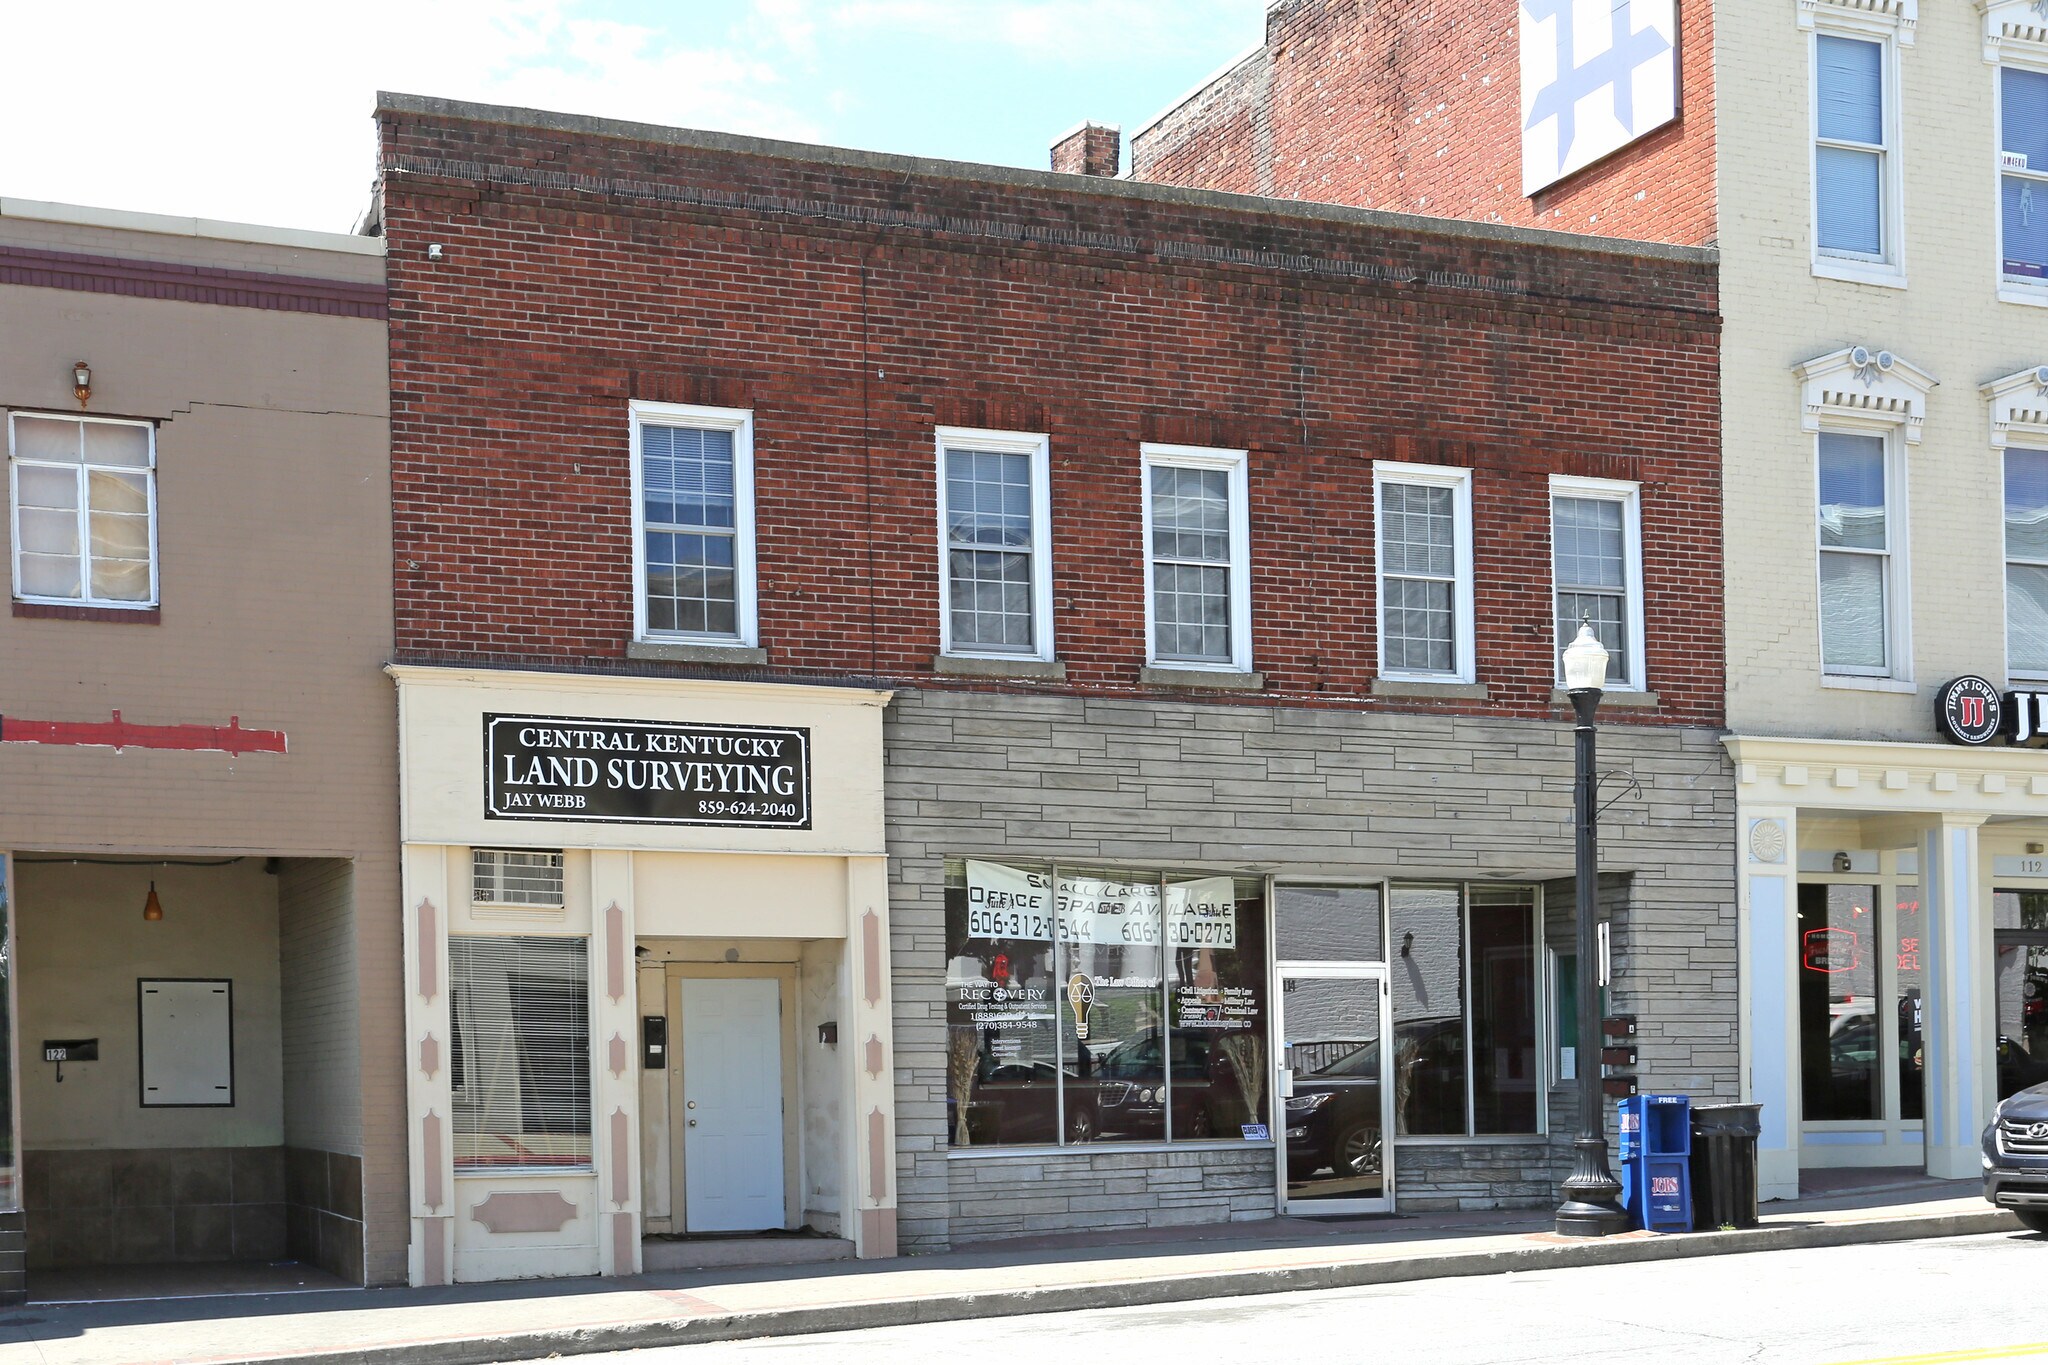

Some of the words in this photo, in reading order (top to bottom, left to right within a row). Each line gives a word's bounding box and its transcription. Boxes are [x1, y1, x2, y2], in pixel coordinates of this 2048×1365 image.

[1949, 681, 1969, 710] JIMMY
[1971, 681, 1997, 712] JOHN'S
[1961, 697, 1984, 728] JJ
[1951, 716, 1970, 738] GOURMET
[518, 728, 640, 751] CENTRAL
[645, 734, 784, 757] KENTUCKY
[503, 754, 599, 788] LAND
[606, 758, 795, 796] SURVEYING
[503, 792, 534, 810] JAY
[536, 794, 586, 809] WEBB
[698, 800, 796, 817] 859-624-2040
[2021, 860, 2042, 873] 112
[970, 887, 1042, 909] OFFICE
[1121, 922, 1233, 943] 606-30-0273
[1094, 976, 1109, 987] The
[1109, 977, 1124, 987] Law
[960, 988, 1046, 1001] RECOVERY
[1181, 987, 1193, 995] Civil
[1194, 987, 1218, 996] Litigation
[1224, 988, 1241, 997] Family
[1242, 988, 1253, 996] Law
[989, 1003, 1004, 1012] Testing
[976, 1021, 1038, 1031] (270)384-9548
[48, 1050, 66, 1060] 122
[1621, 1113, 1640, 1130] JOBS
[1651, 1177, 1679, 1193] JOBS
